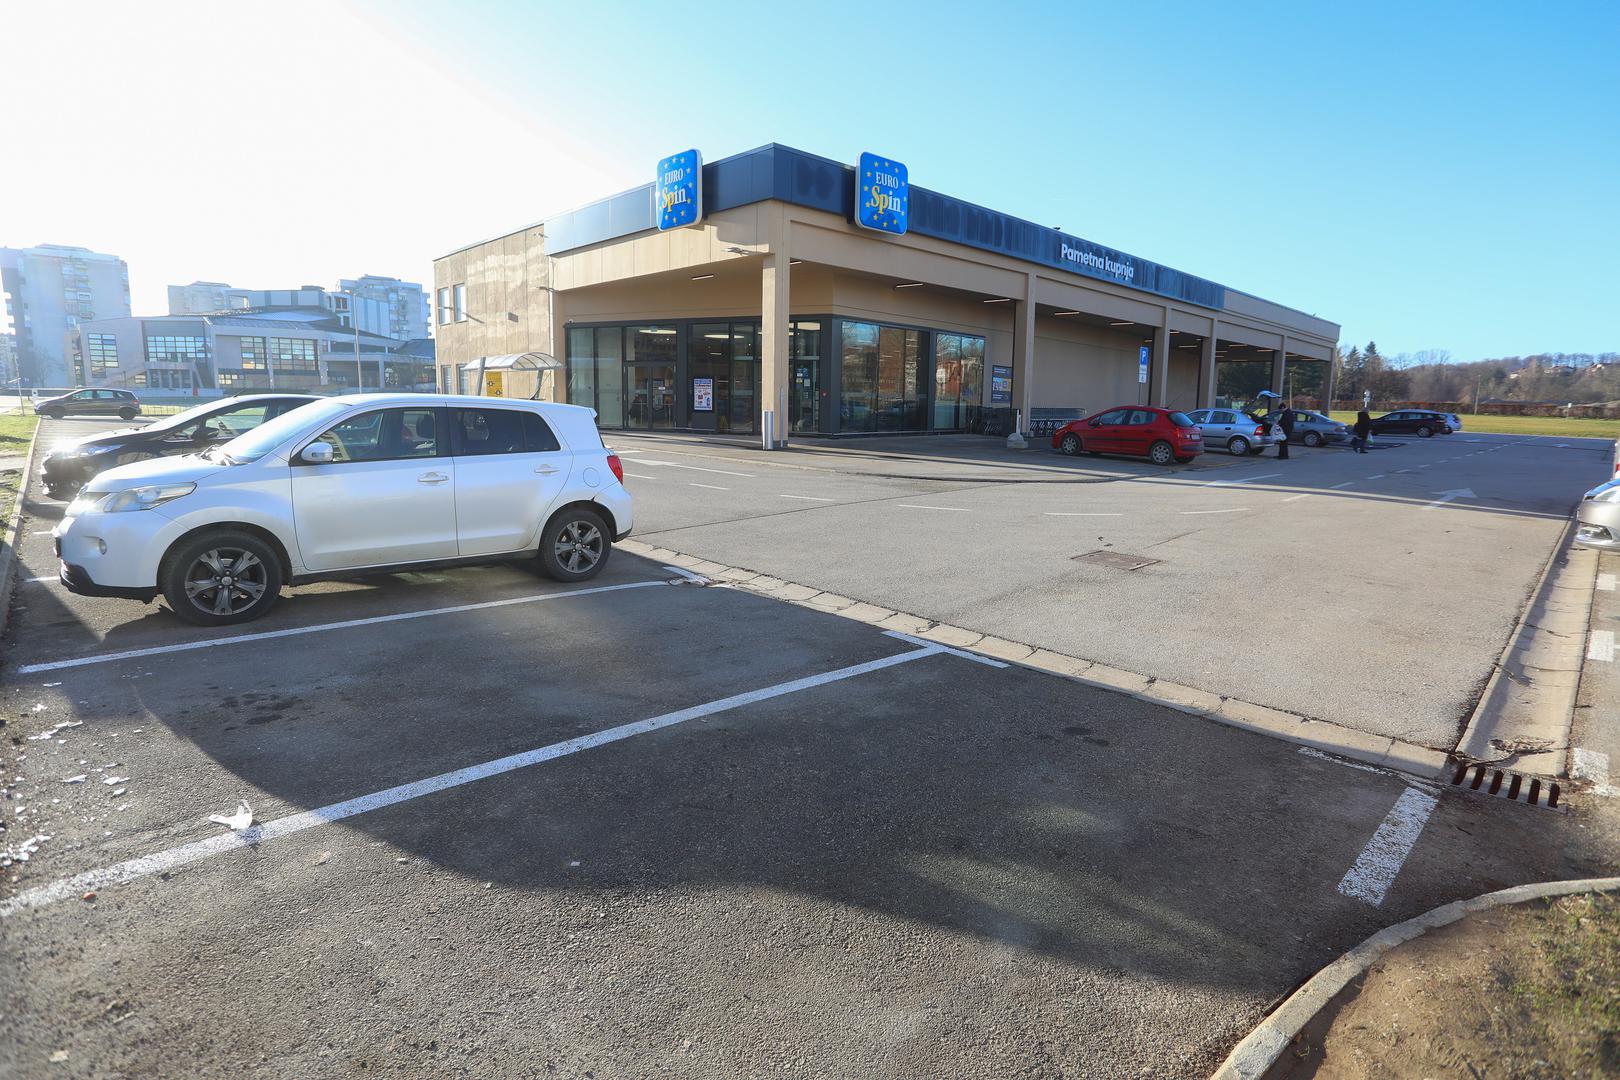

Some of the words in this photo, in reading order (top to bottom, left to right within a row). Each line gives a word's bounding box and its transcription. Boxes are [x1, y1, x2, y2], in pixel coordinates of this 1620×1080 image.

[665, 168, 684, 185] EURO
[875, 171, 899, 189] EURO
[662, 185, 687, 212] Spin
[870, 186, 901, 215] Spin
[1061, 243, 1104, 270] Pametna
[1105, 256, 1134, 280] kupnja
